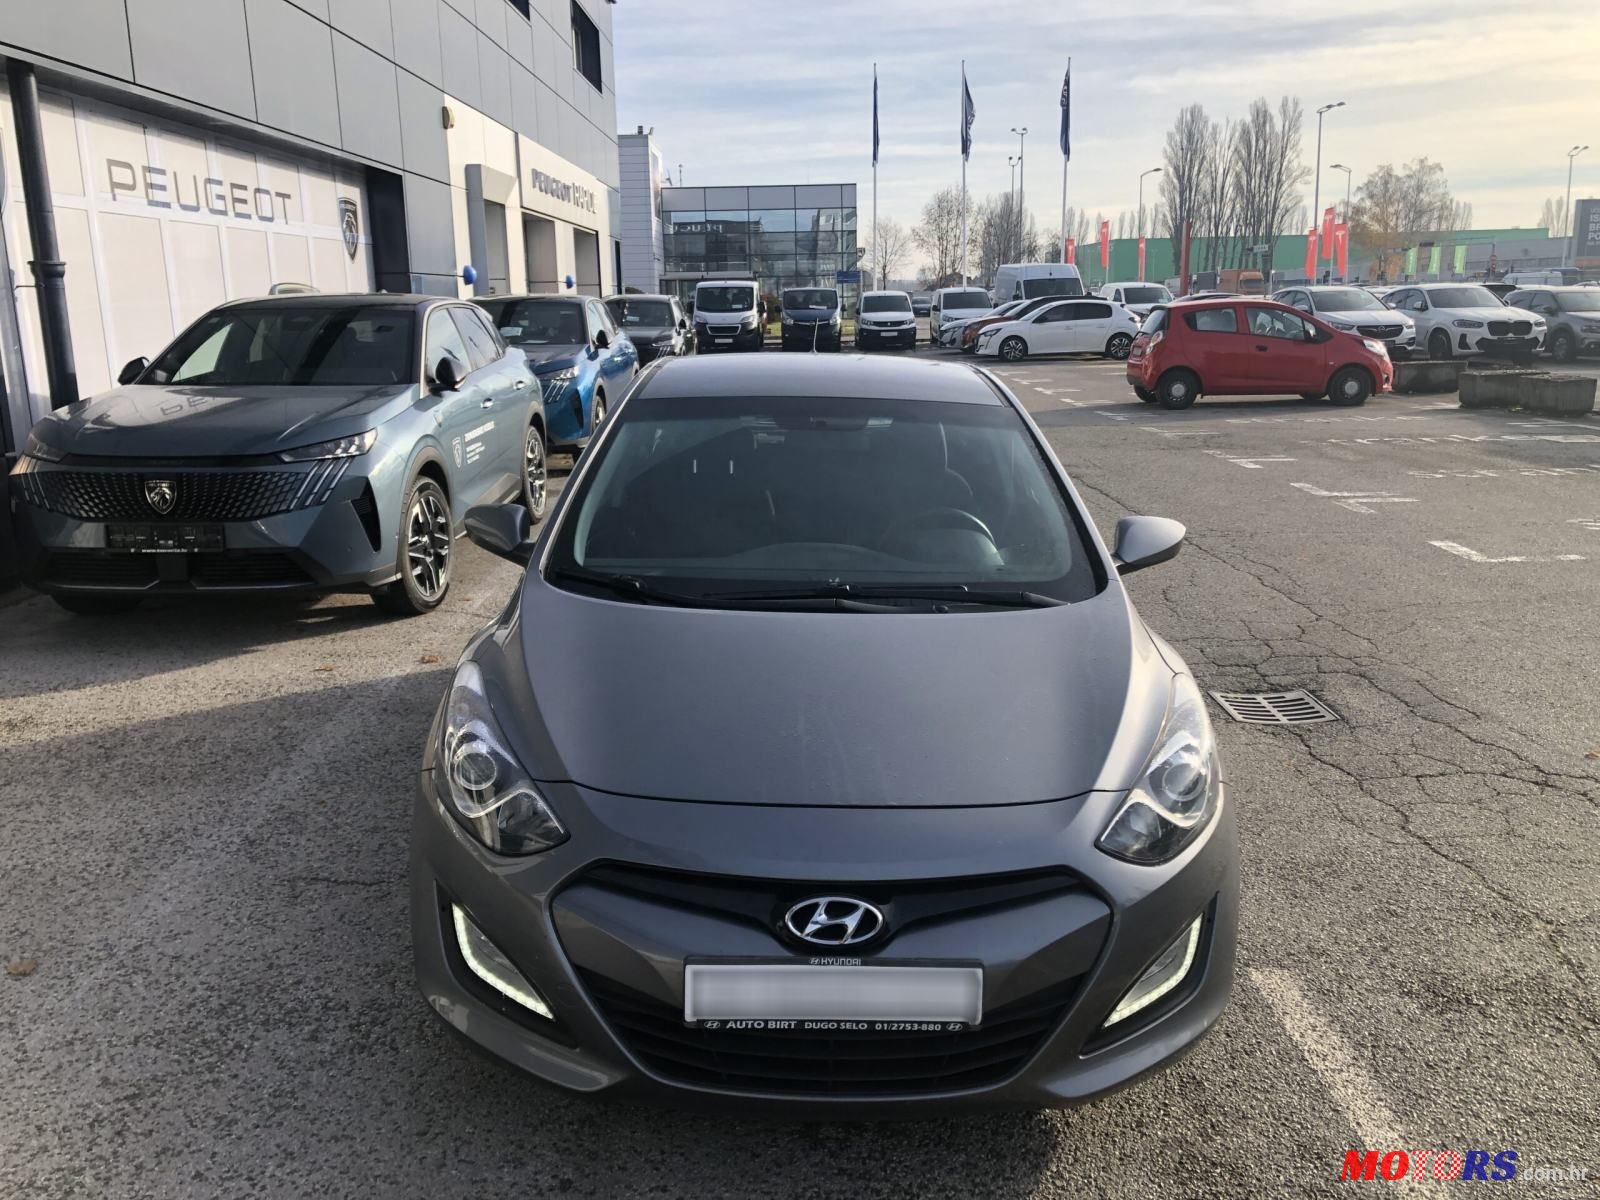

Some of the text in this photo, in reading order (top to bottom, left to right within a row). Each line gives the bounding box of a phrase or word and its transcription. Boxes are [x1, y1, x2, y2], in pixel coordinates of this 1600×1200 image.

[106, 157, 292, 226] PEUGEOT
[531, 168, 571, 203] PEUGEOT
[821, 957, 861, 966] HYUNDAI
[726, 1020, 941, 1031] AUTO BIRT DUGO SELO 01/2753-880
